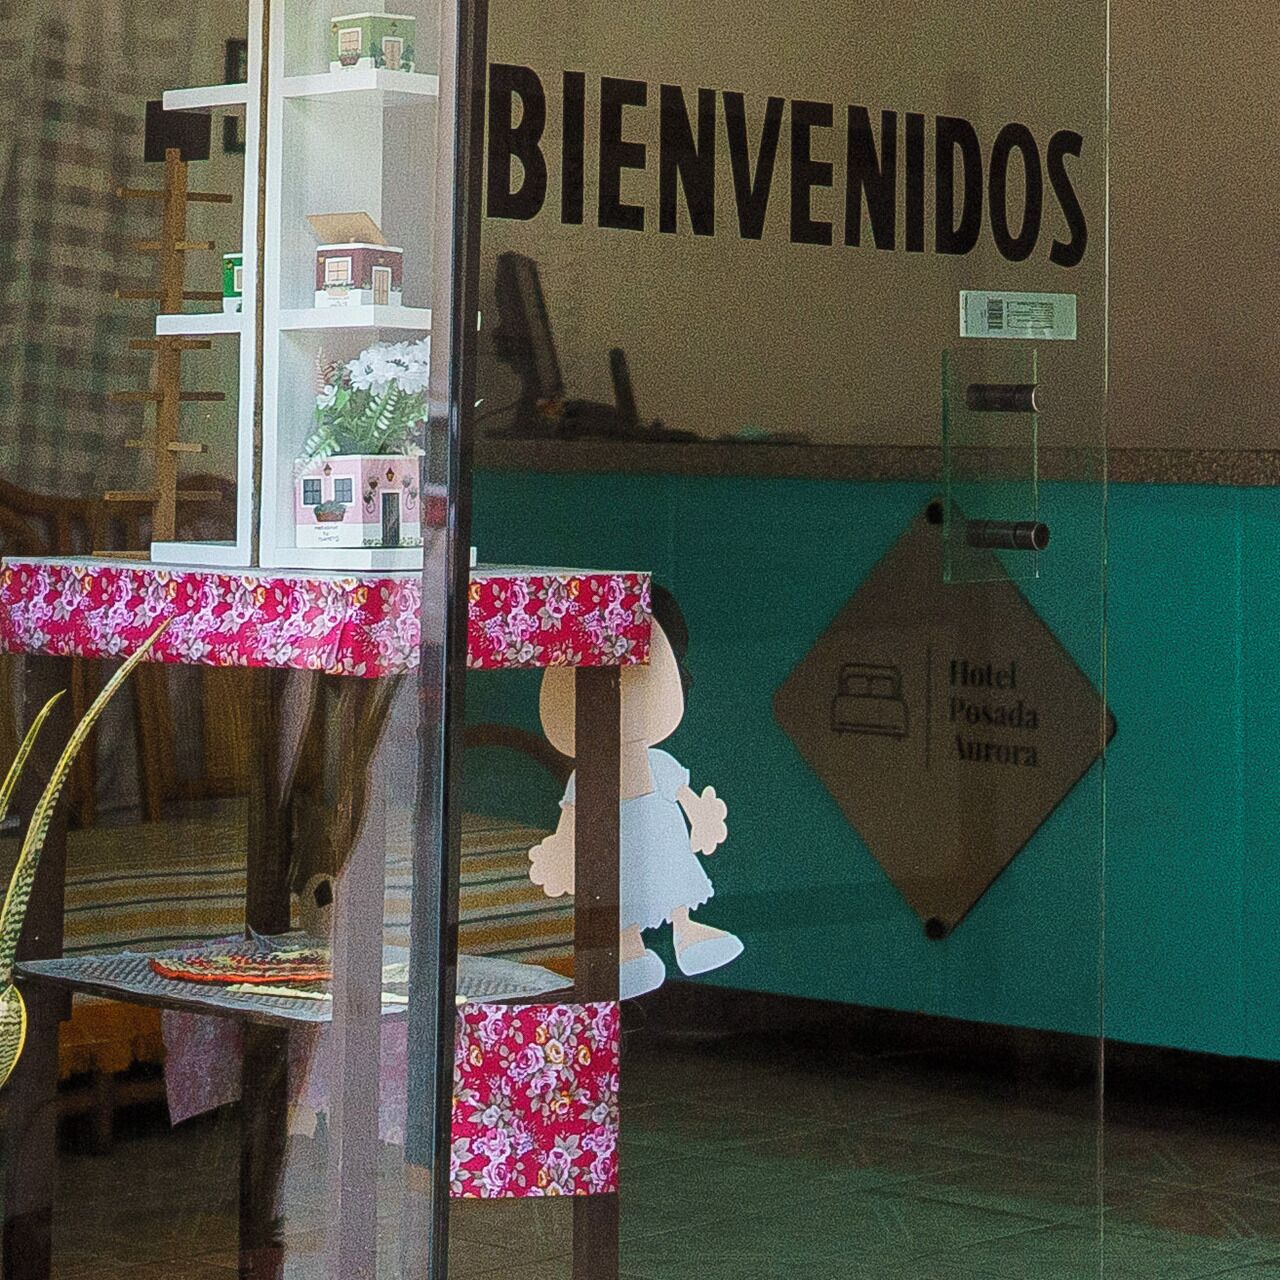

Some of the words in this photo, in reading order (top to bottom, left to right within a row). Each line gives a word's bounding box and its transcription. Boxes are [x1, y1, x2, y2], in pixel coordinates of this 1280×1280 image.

[486, 61, 1088, 268] BIENVENIDOS
[949, 660, 1016, 688] Hotel
[949, 698, 1039, 728] Posada
[955, 735, 1038, 767] Aurora
